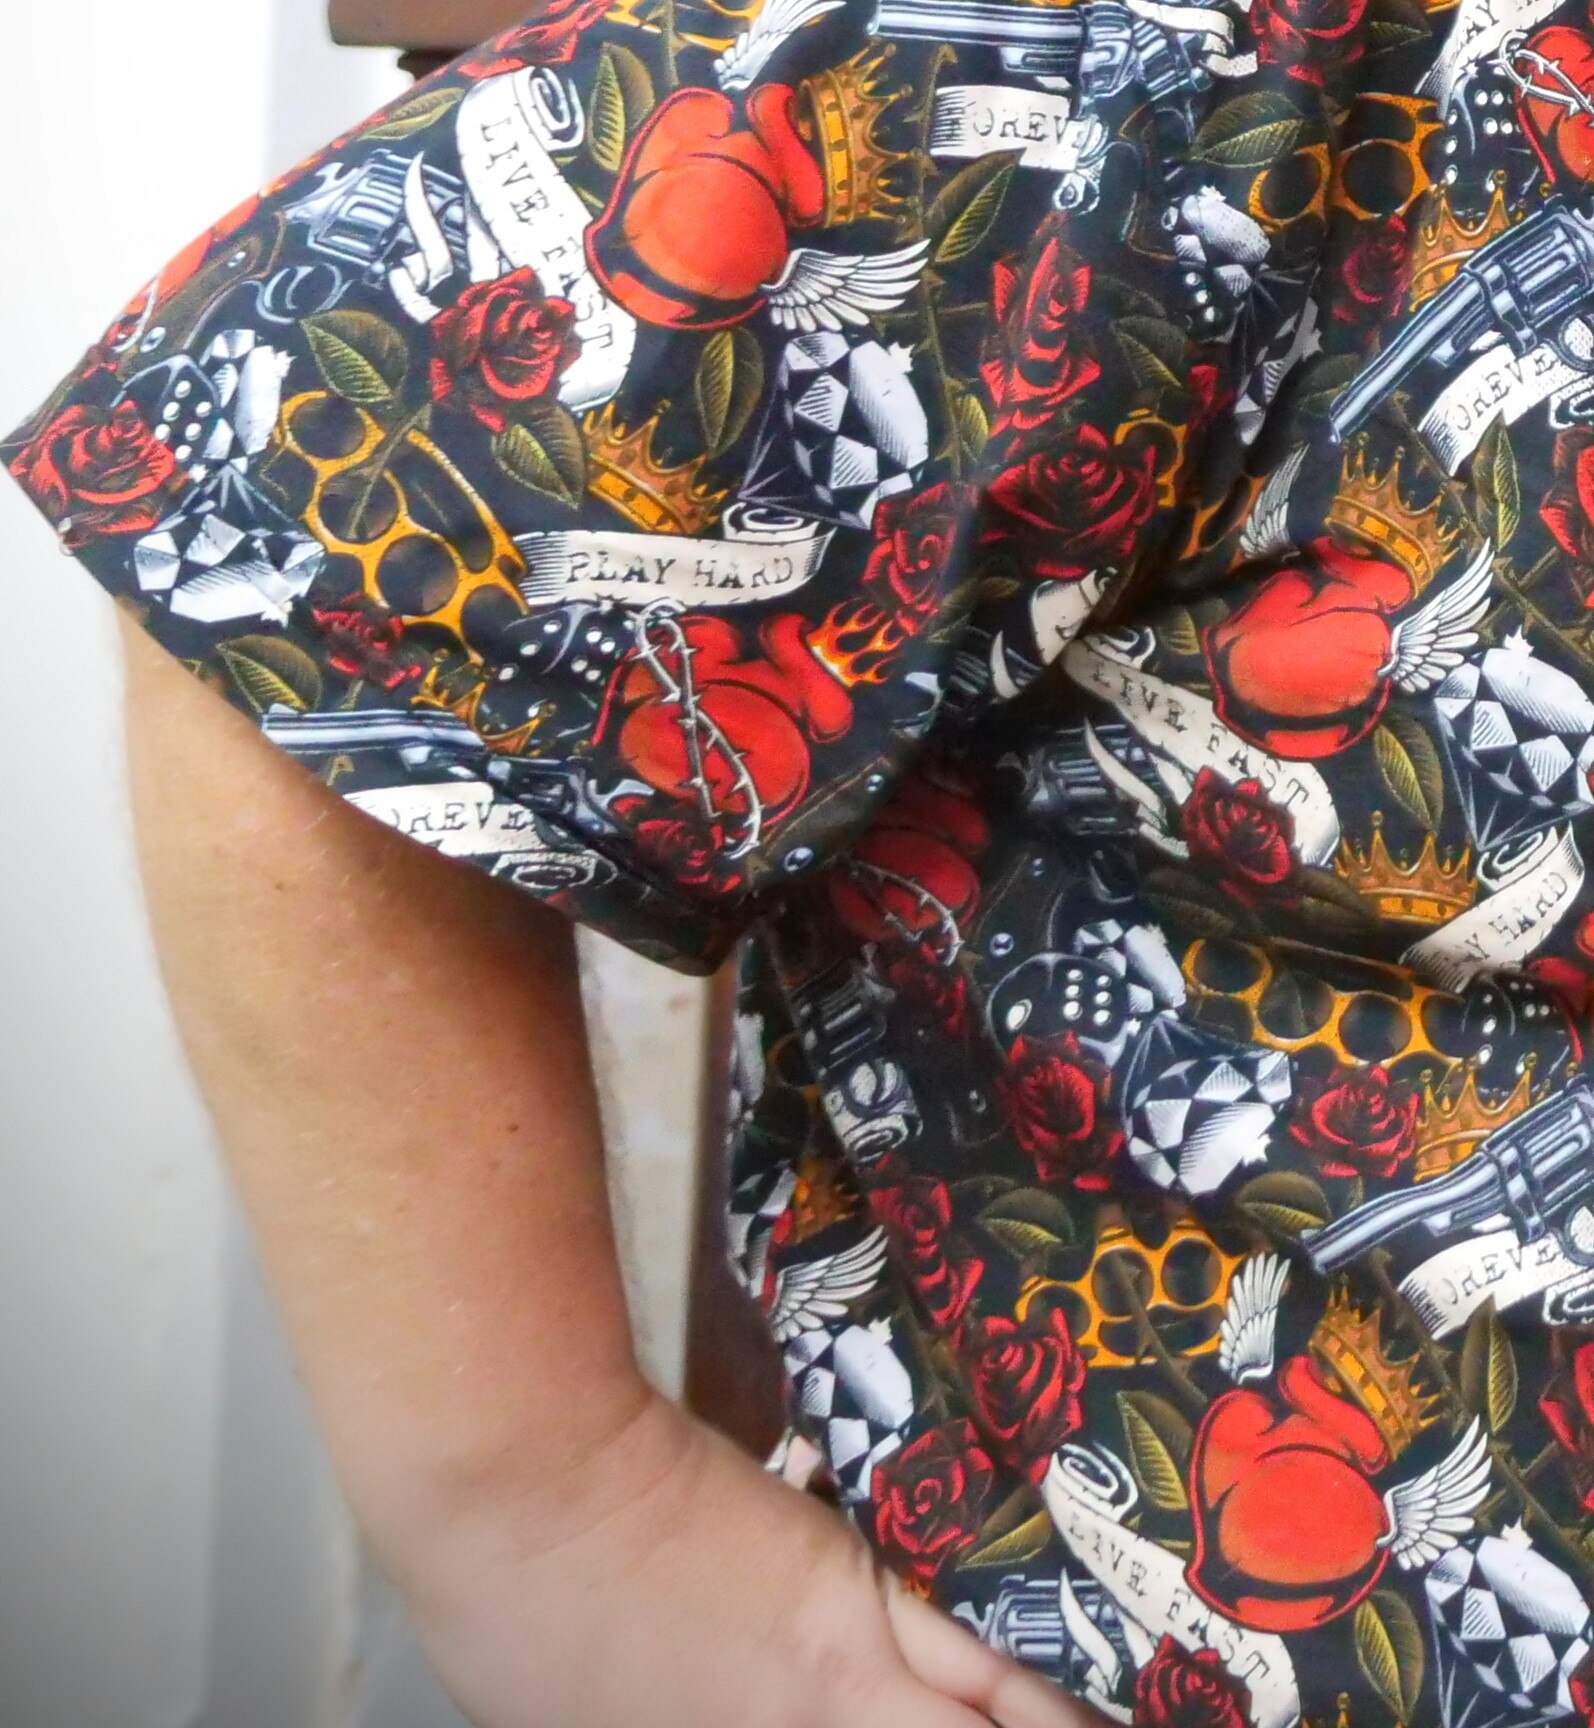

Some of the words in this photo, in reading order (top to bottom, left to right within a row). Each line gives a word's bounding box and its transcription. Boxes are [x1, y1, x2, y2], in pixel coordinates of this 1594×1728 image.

[480, 116, 550, 226] LIVE
[566, 550, 676, 584] PLAY
[695, 556, 793, 588] HARD
[1093, 663, 1188, 733] LIVE
[1069, 1513, 1147, 1598] LIVE
